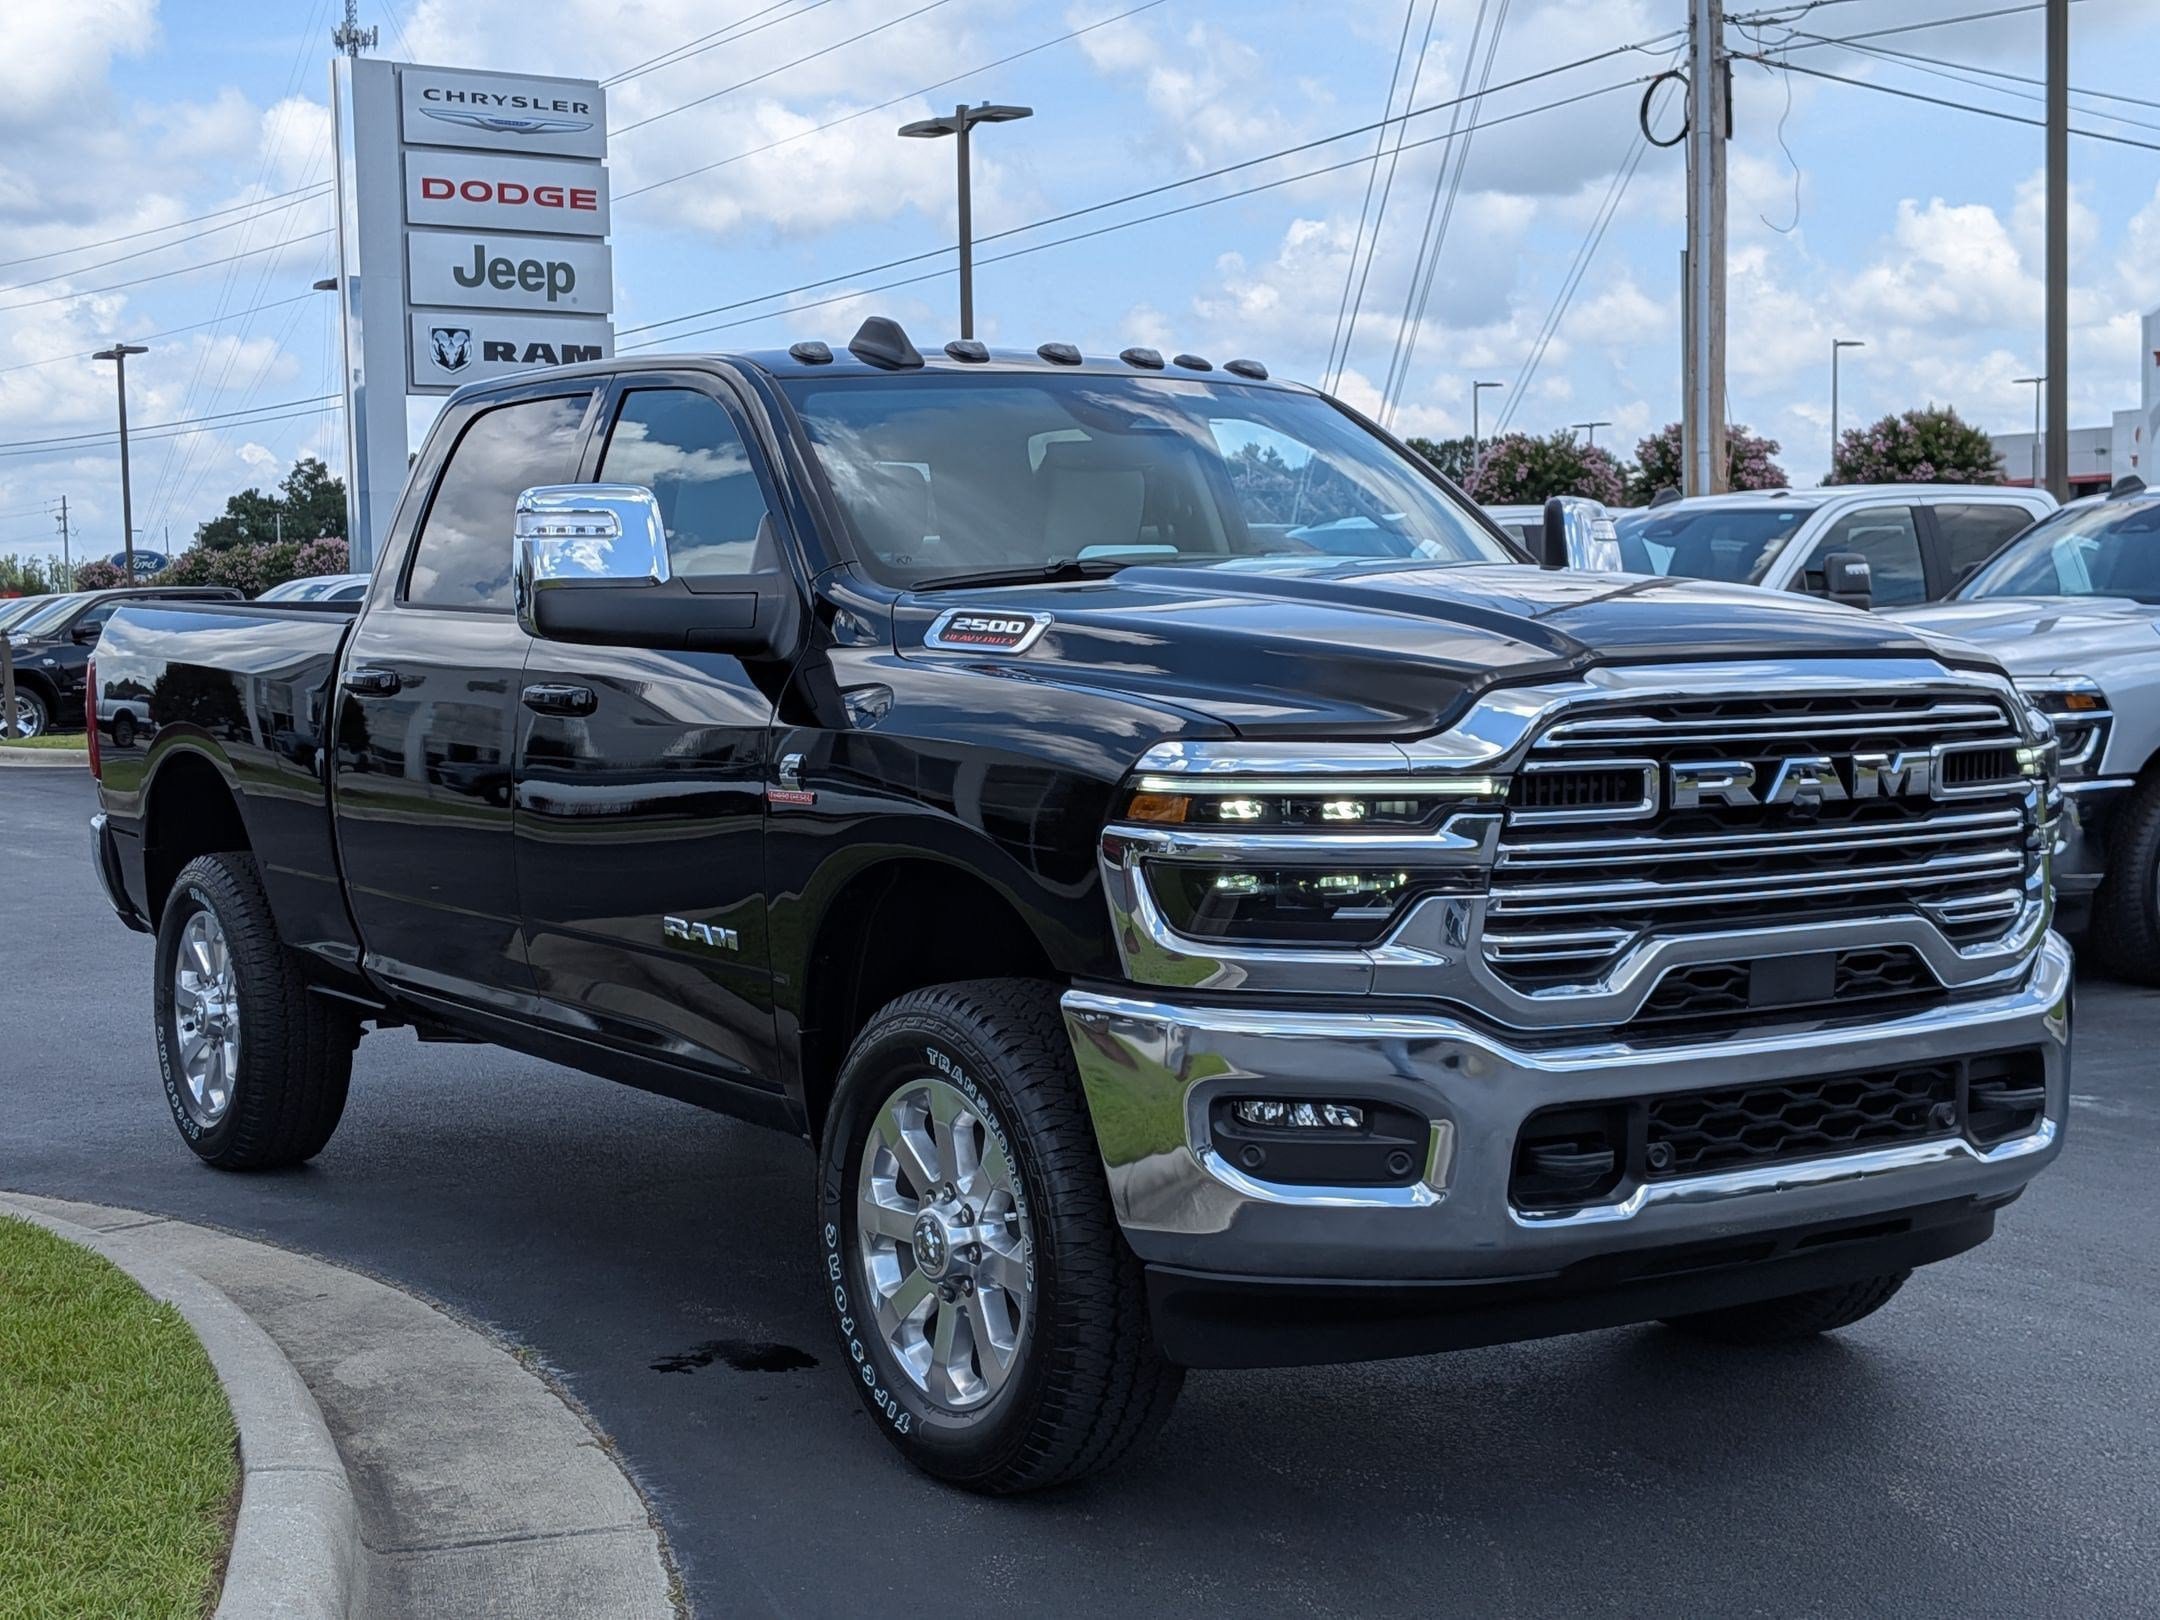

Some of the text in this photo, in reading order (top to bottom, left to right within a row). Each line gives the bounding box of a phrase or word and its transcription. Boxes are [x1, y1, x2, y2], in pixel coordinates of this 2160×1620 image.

[422, 88, 590, 115] CHRYSLER
[421, 177, 597, 211] DODGE
[453, 244, 576, 302] Jeep
[483, 340, 602, 365] RAM
[123, 554, 158, 570] Ford
[951, 618, 1025, 634] 2500
[1669, 751, 1931, 809] RAM
[664, 916, 739, 951] RAM
